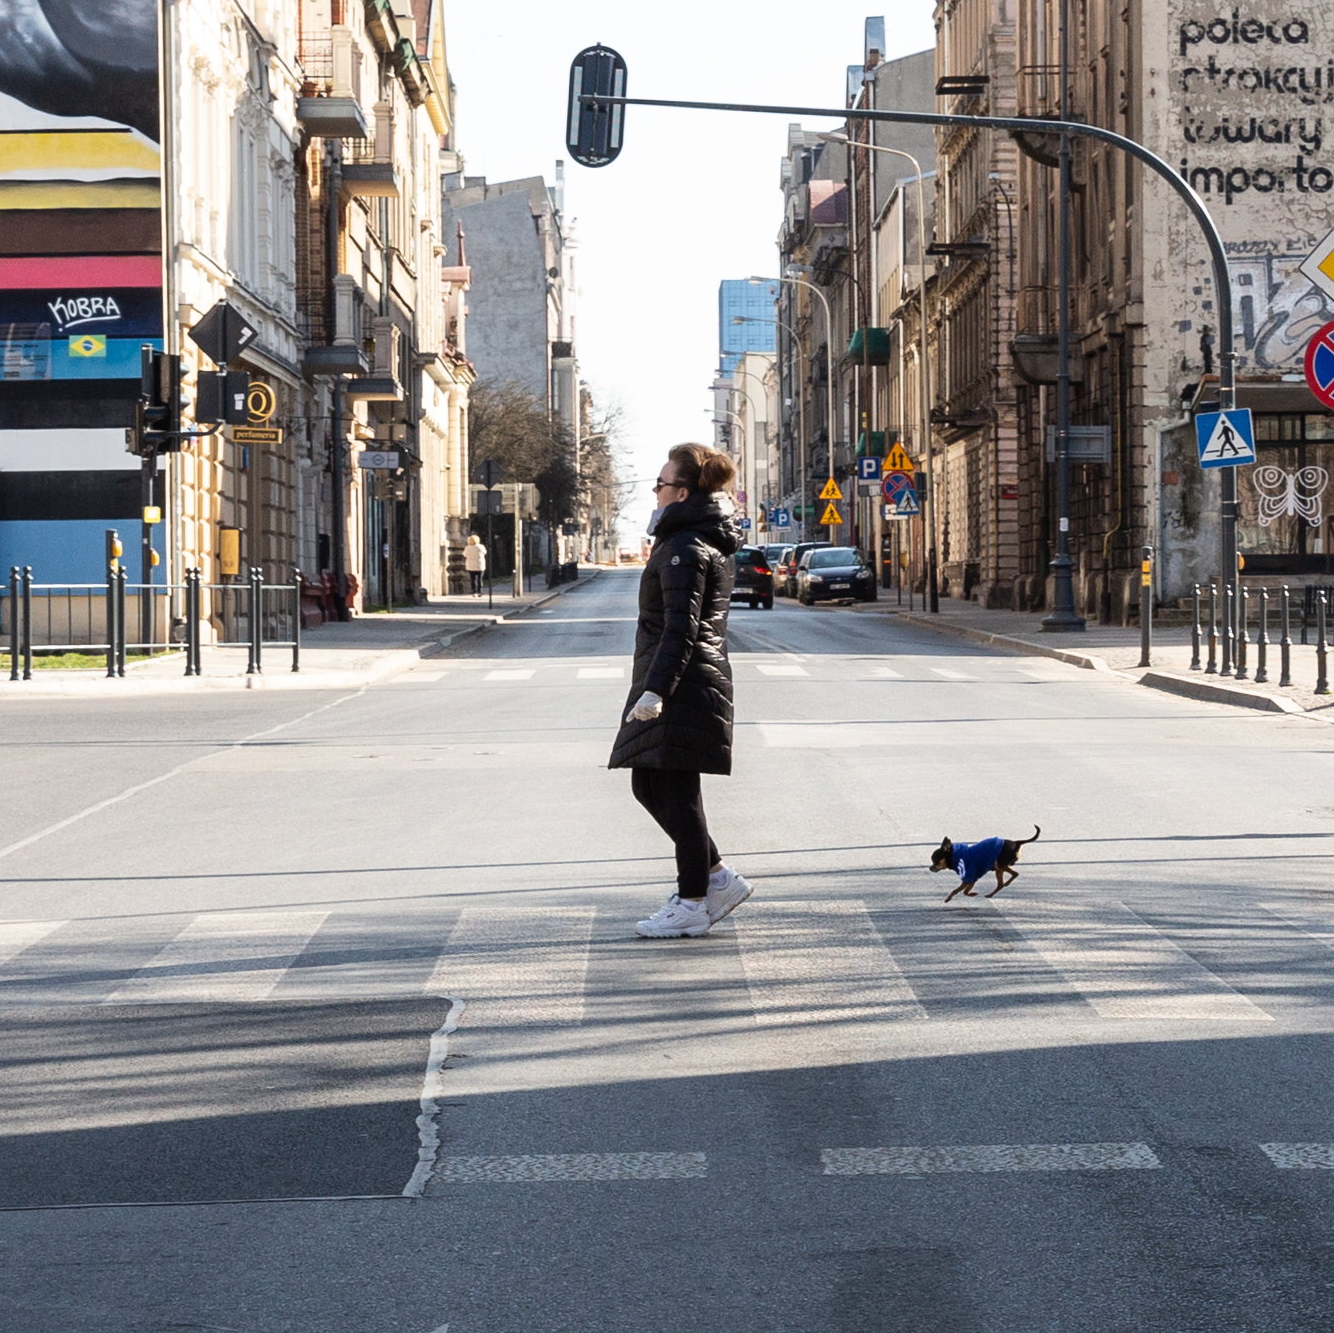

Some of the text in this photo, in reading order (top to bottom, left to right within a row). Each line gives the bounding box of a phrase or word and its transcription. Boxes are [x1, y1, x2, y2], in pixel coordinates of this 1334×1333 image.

[1180, 7, 1310, 56] poleca
[48, 296, 121, 325] KOBRA
[862, 459, 876, 478] P
[778, 513, 788, 526] P
